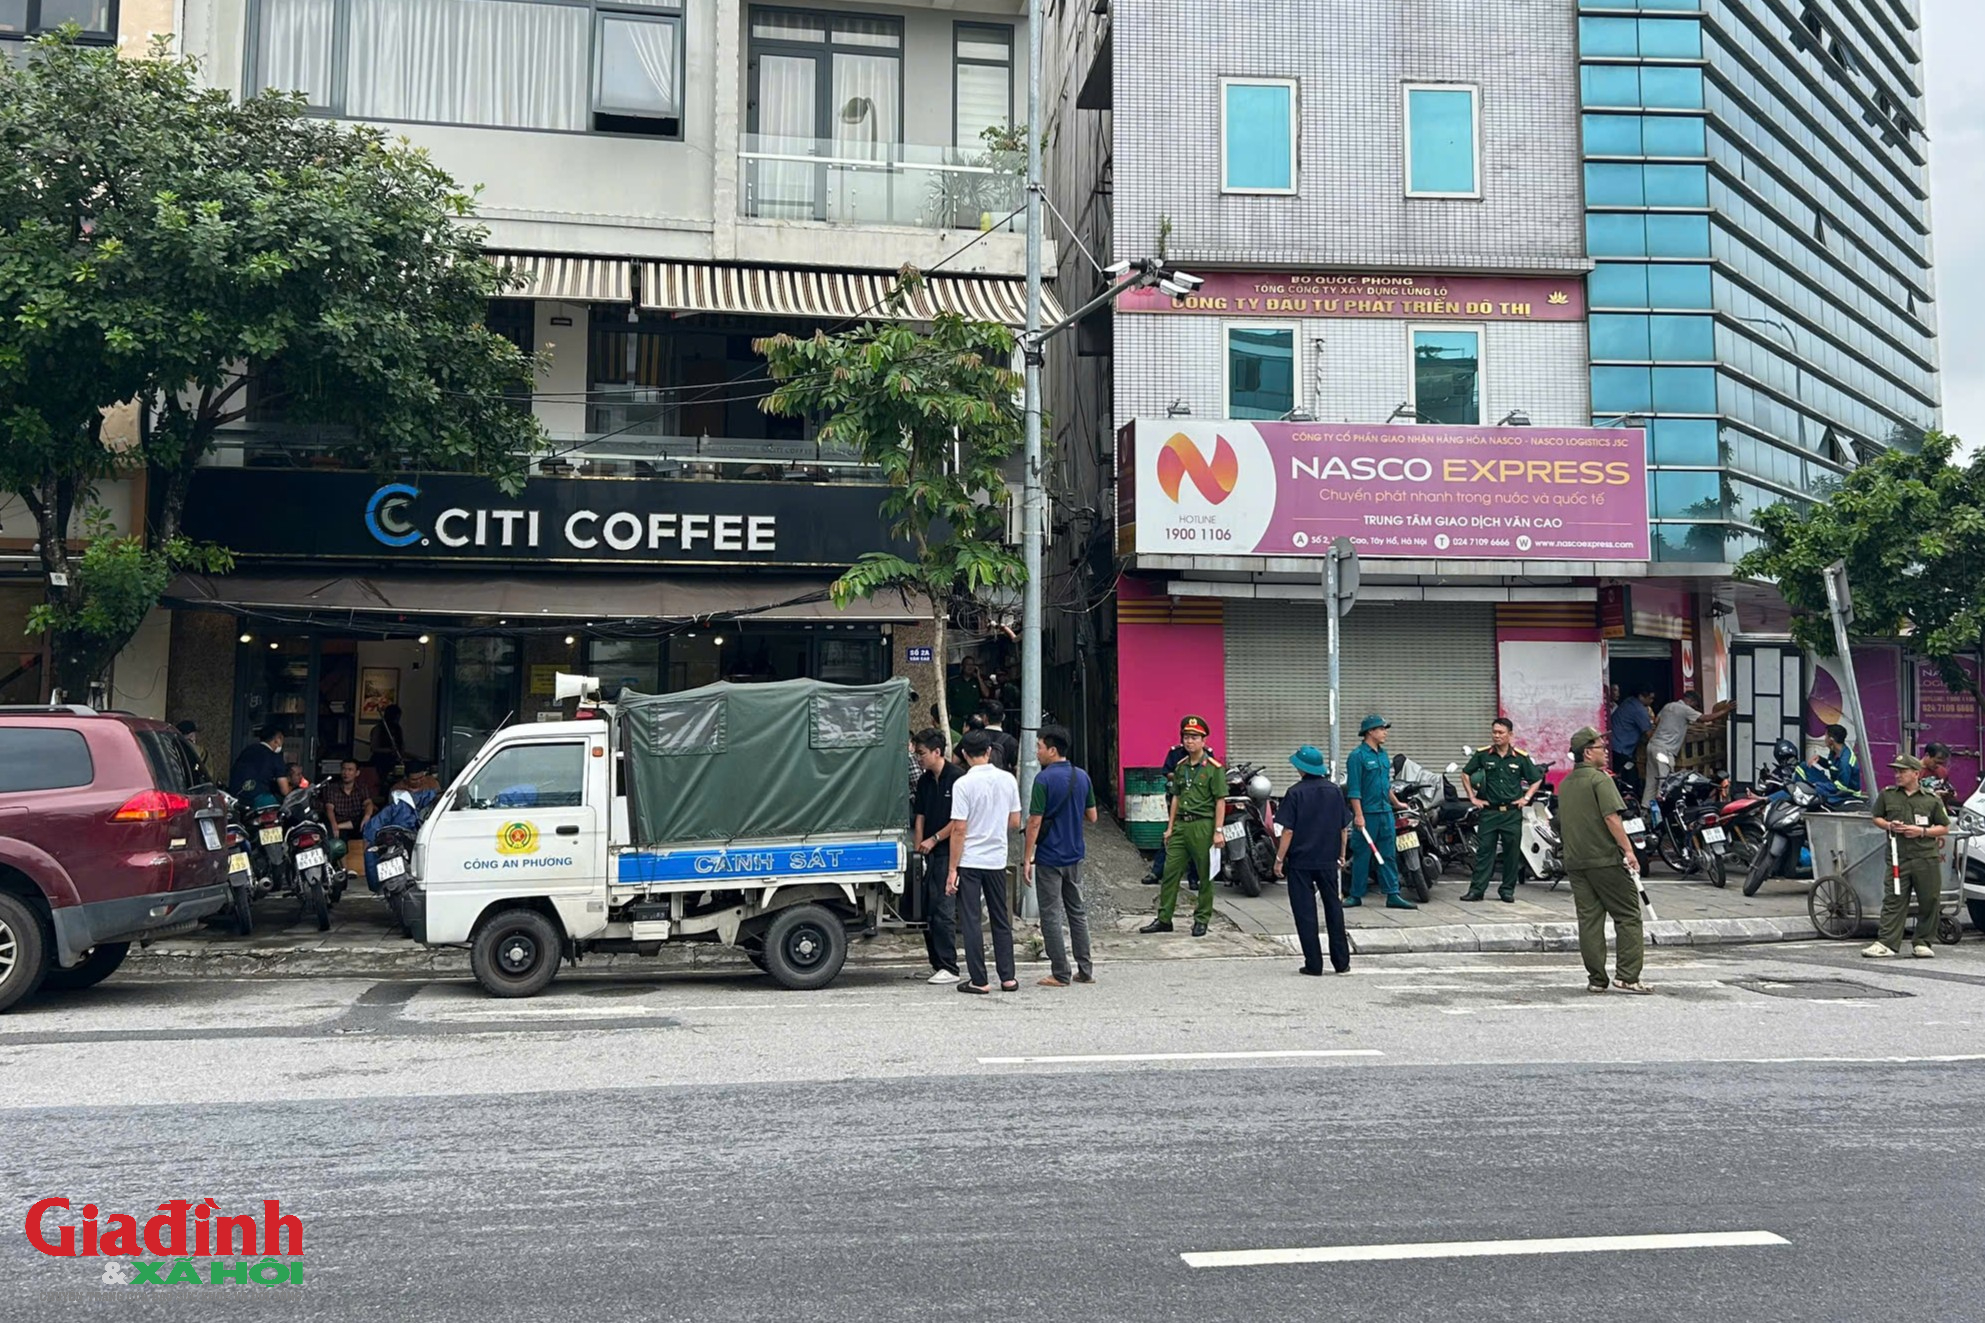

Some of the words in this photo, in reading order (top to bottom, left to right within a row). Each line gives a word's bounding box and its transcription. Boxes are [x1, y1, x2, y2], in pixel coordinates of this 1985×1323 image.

[1322, 286, 1337, 294] TY
[1235, 298, 1260, 310] TY
[1312, 298, 1341, 311] TƯ
[1465, 298, 1493, 315] ĐÔ
[1499, 302, 1531, 318] THỊ
[1324, 433, 1334, 442] TY
[1380, 434, 1405, 443] GIAO
[1489, 436, 1523, 446] NASCO
[1530, 437, 1564, 446] NASCO
[1565, 437, 1611, 447] LOGISTICS
[1612, 438, 1629, 447] JSC
[1291, 456, 1433, 482] NASCO
[1443, 459, 1631, 485] EXPRESS
[1319, 486, 1372, 503] Chuyển
[1375, 488, 1407, 504] phát
[1410, 490, 1453, 503] nhanh
[1456, 492, 1492, 506] trong
[1494, 490, 1529, 504] nước
[1532, 492, 1550, 505] và
[1552, 490, 1588, 507] quốc
[1591, 491, 1606, 506] tế
[1179, 515, 1216, 524] HOTLINE
[1363, 515, 1404, 526] TRUNG
[1406, 513, 1433, 527] TÂM
[1434, 516, 1469, 527] GIAO
[1471, 515, 1501, 529] DỊCH
[1504, 515, 1531, 528] VĂN
[1533, 517, 1563, 528] CAO
[434, 507, 540, 548] CITI
[563, 509, 777, 551] COFFEE
[1165, 528, 1196, 540] 1900
[1202, 528, 1232, 541] 1106
[1311, 535, 1322, 545] Số
[1370, 536, 1384, 547] Tây
[1401, 536, 1413, 545] Hà
[1414, 536, 1428, 547] Nội
[1452, 537, 1468, 547] 024
[1469, 538, 1489, 547] 7109
[1490, 538, 1510, 547] 6666
[1534, 539, 1634, 550] www.nascoexpress.com
[463, 858, 499, 870] CÔNG
[502, 859, 519, 869] AN
[694, 849, 774, 874] CẢNH
[789, 846, 844, 870] SÁT
